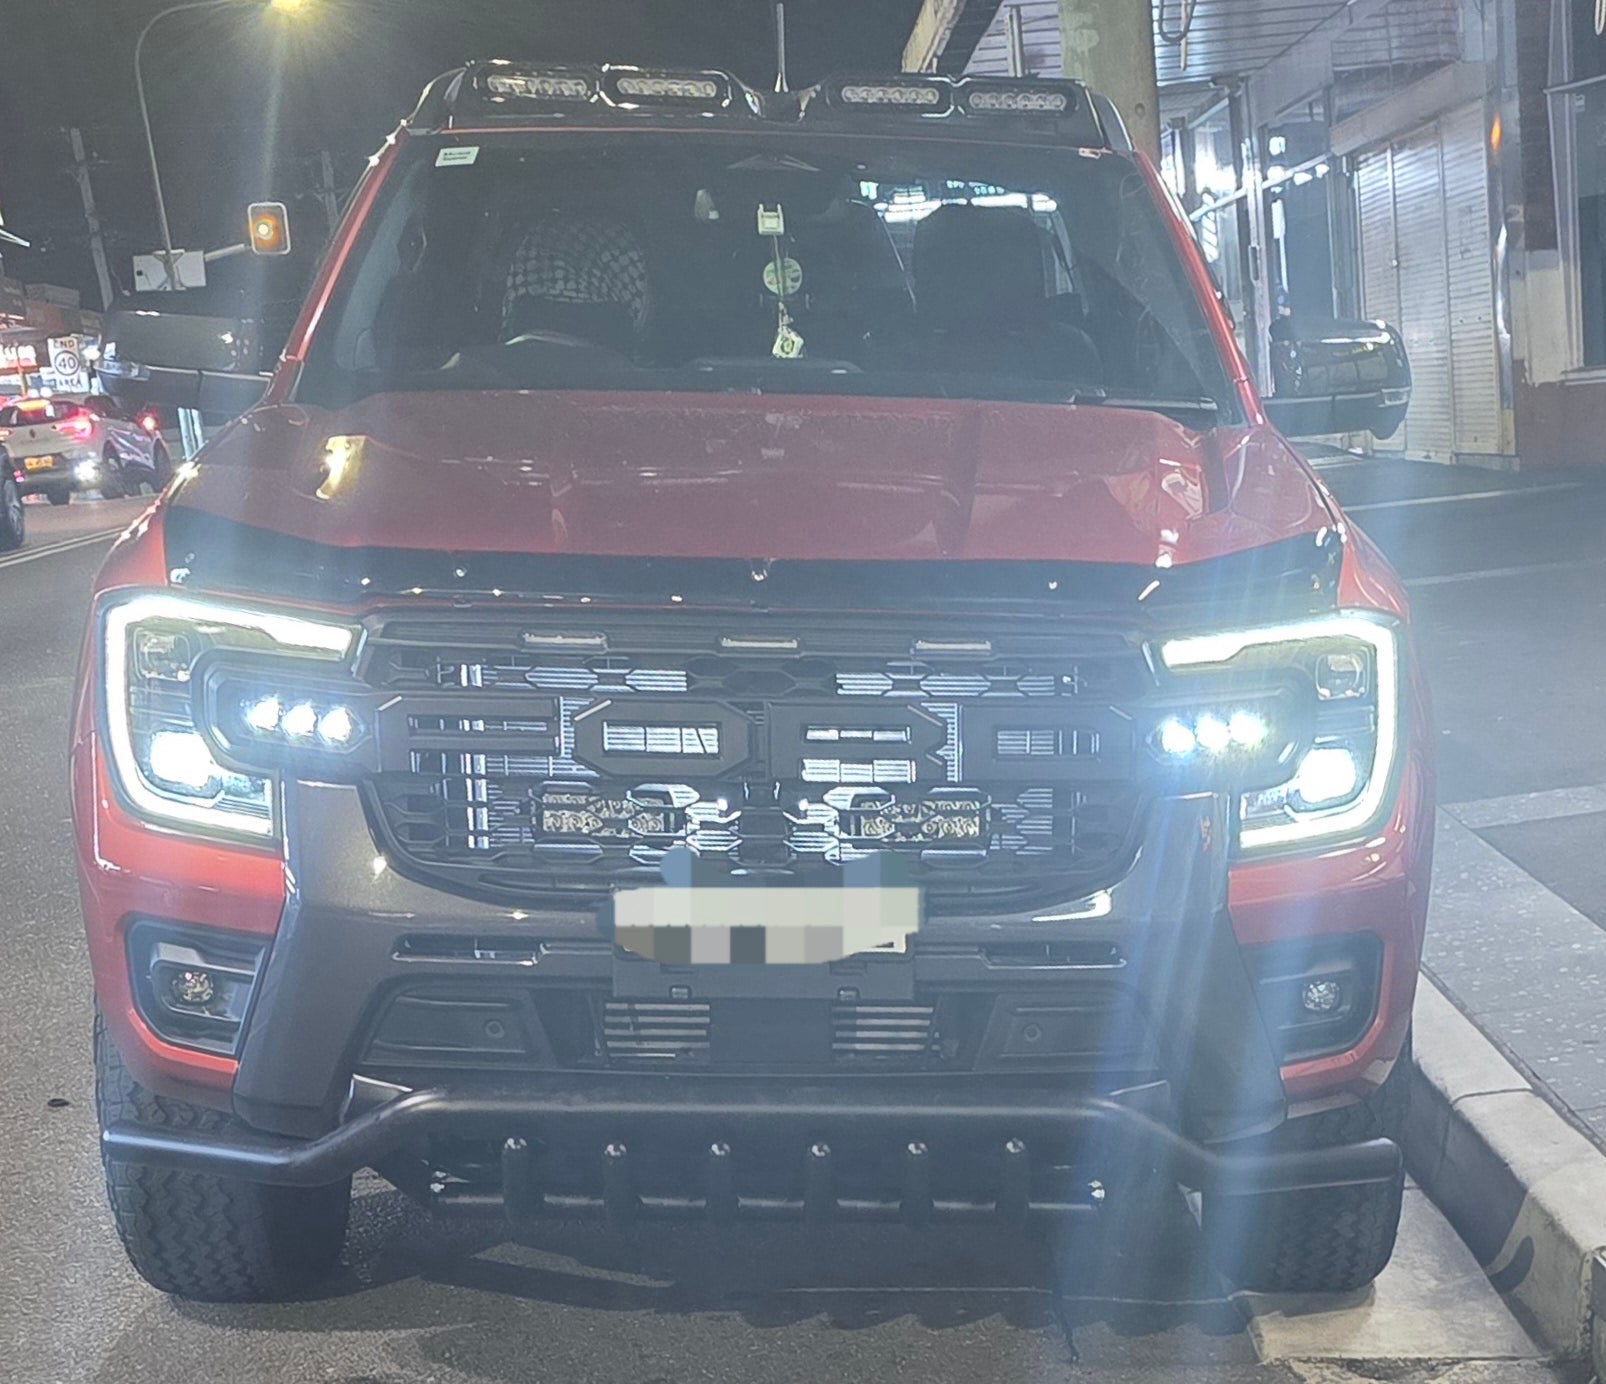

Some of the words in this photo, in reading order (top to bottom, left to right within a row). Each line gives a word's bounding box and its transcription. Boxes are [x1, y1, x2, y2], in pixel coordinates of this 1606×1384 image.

[54, 340, 75, 349] END
[58, 356, 77, 370] 40
[375, 695, 1137, 783] FORD
